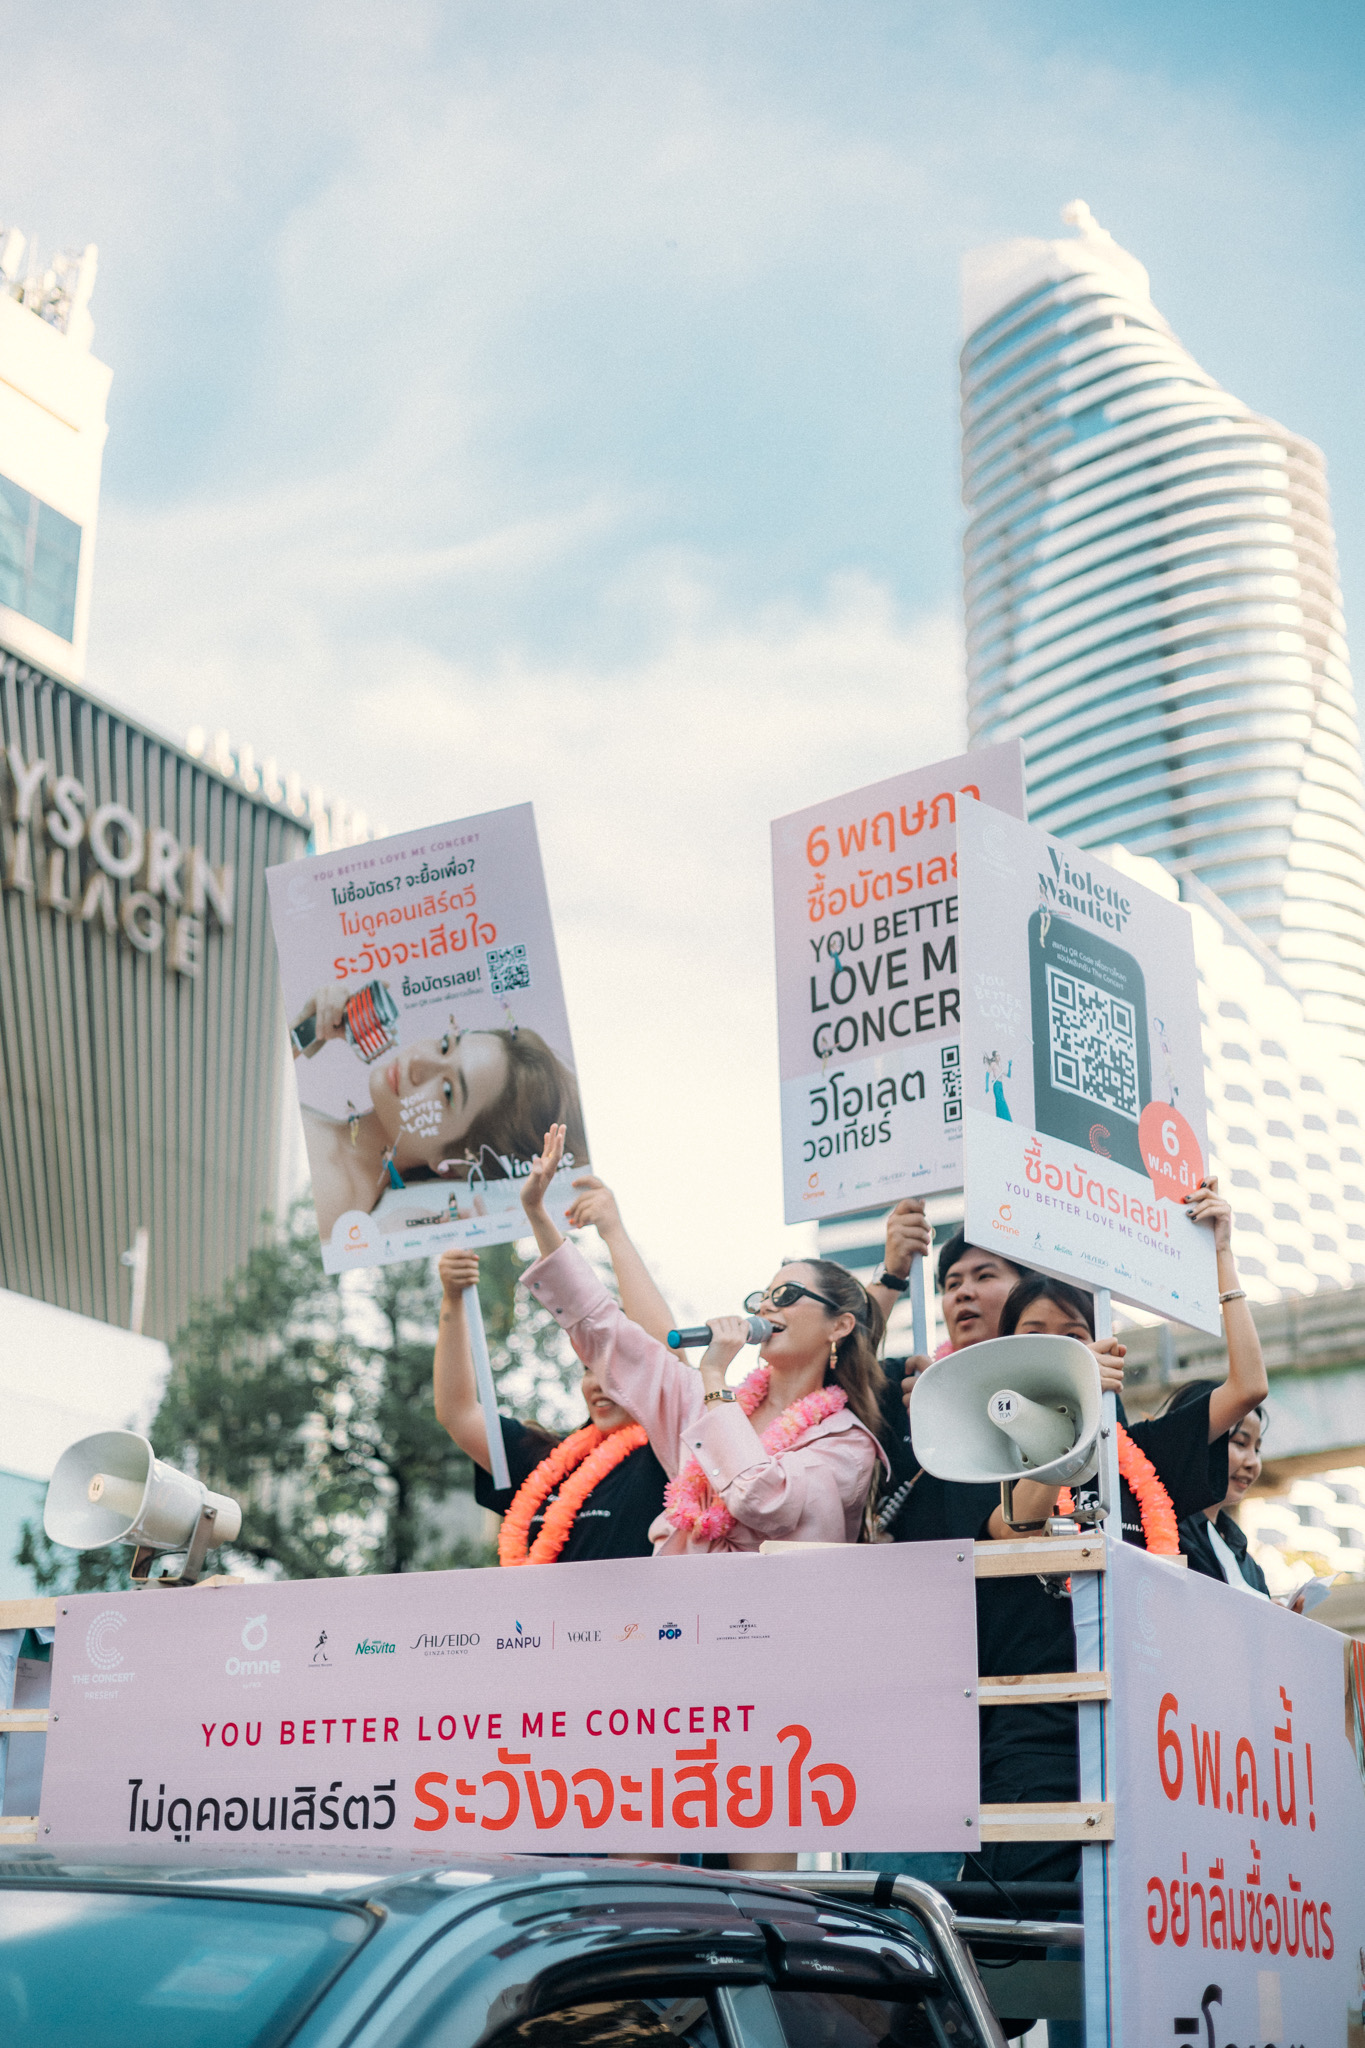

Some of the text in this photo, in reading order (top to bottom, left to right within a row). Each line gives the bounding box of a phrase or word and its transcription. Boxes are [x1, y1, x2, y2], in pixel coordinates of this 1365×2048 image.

[313, 833, 480, 881] YOU BETTER LOVE ME CONCERT
[806, 824, 830, 868] 6
[1038, 872, 1127, 933] Wautier
[1046, 845, 1132, 915] Violette
[339, 883, 477, 937] ไม่ดูคอนเสิร์ตวี
[810, 895, 959, 963] YOU BETTE
[333, 912, 497, 980] ระวังจะเสียใจ
[402, 967, 482, 997] ซื้อบัตรเลย!
[810, 935, 957, 1013] LOVE M
[812, 988, 960, 1060] CONCER
[809, 1070, 926, 1126] วิโอเลต
[406, 1110, 442, 1134] LOVE
[803, 1110, 893, 1162] วอเทียร์
[1161, 1120, 1180, 1157] 6
[1024, 1136, 1169, 1238] ซื้อบัตรเลย!
[992, 1219, 1020, 1237] Omne
[1006, 1181, 1182, 1260] YOU BETTER LOVE ME CONCERT
[355, 1640, 396, 1656] Nesvita
[410, 1633, 481, 1649] SHISEIDO
[496, 1636, 541, 1650] BANPU
[567, 1630, 602, 1643] VOGUE
[659, 1628, 682, 1641] POP
[72, 1672, 136, 1685] THE CONCERT
[225, 1657, 281, 1676] Omne
[85, 1690, 119, 1700] PRESENT
[201, 1705, 755, 1747] YOU BETTER LOVE ME CONCERT
[128, 1724, 857, 1843] ไม่ดูคอนเสิร์ตวี ระวังจะเสียใจ
[1146, 1838, 1335, 1961] อย่าลืมซื้อบัตร
